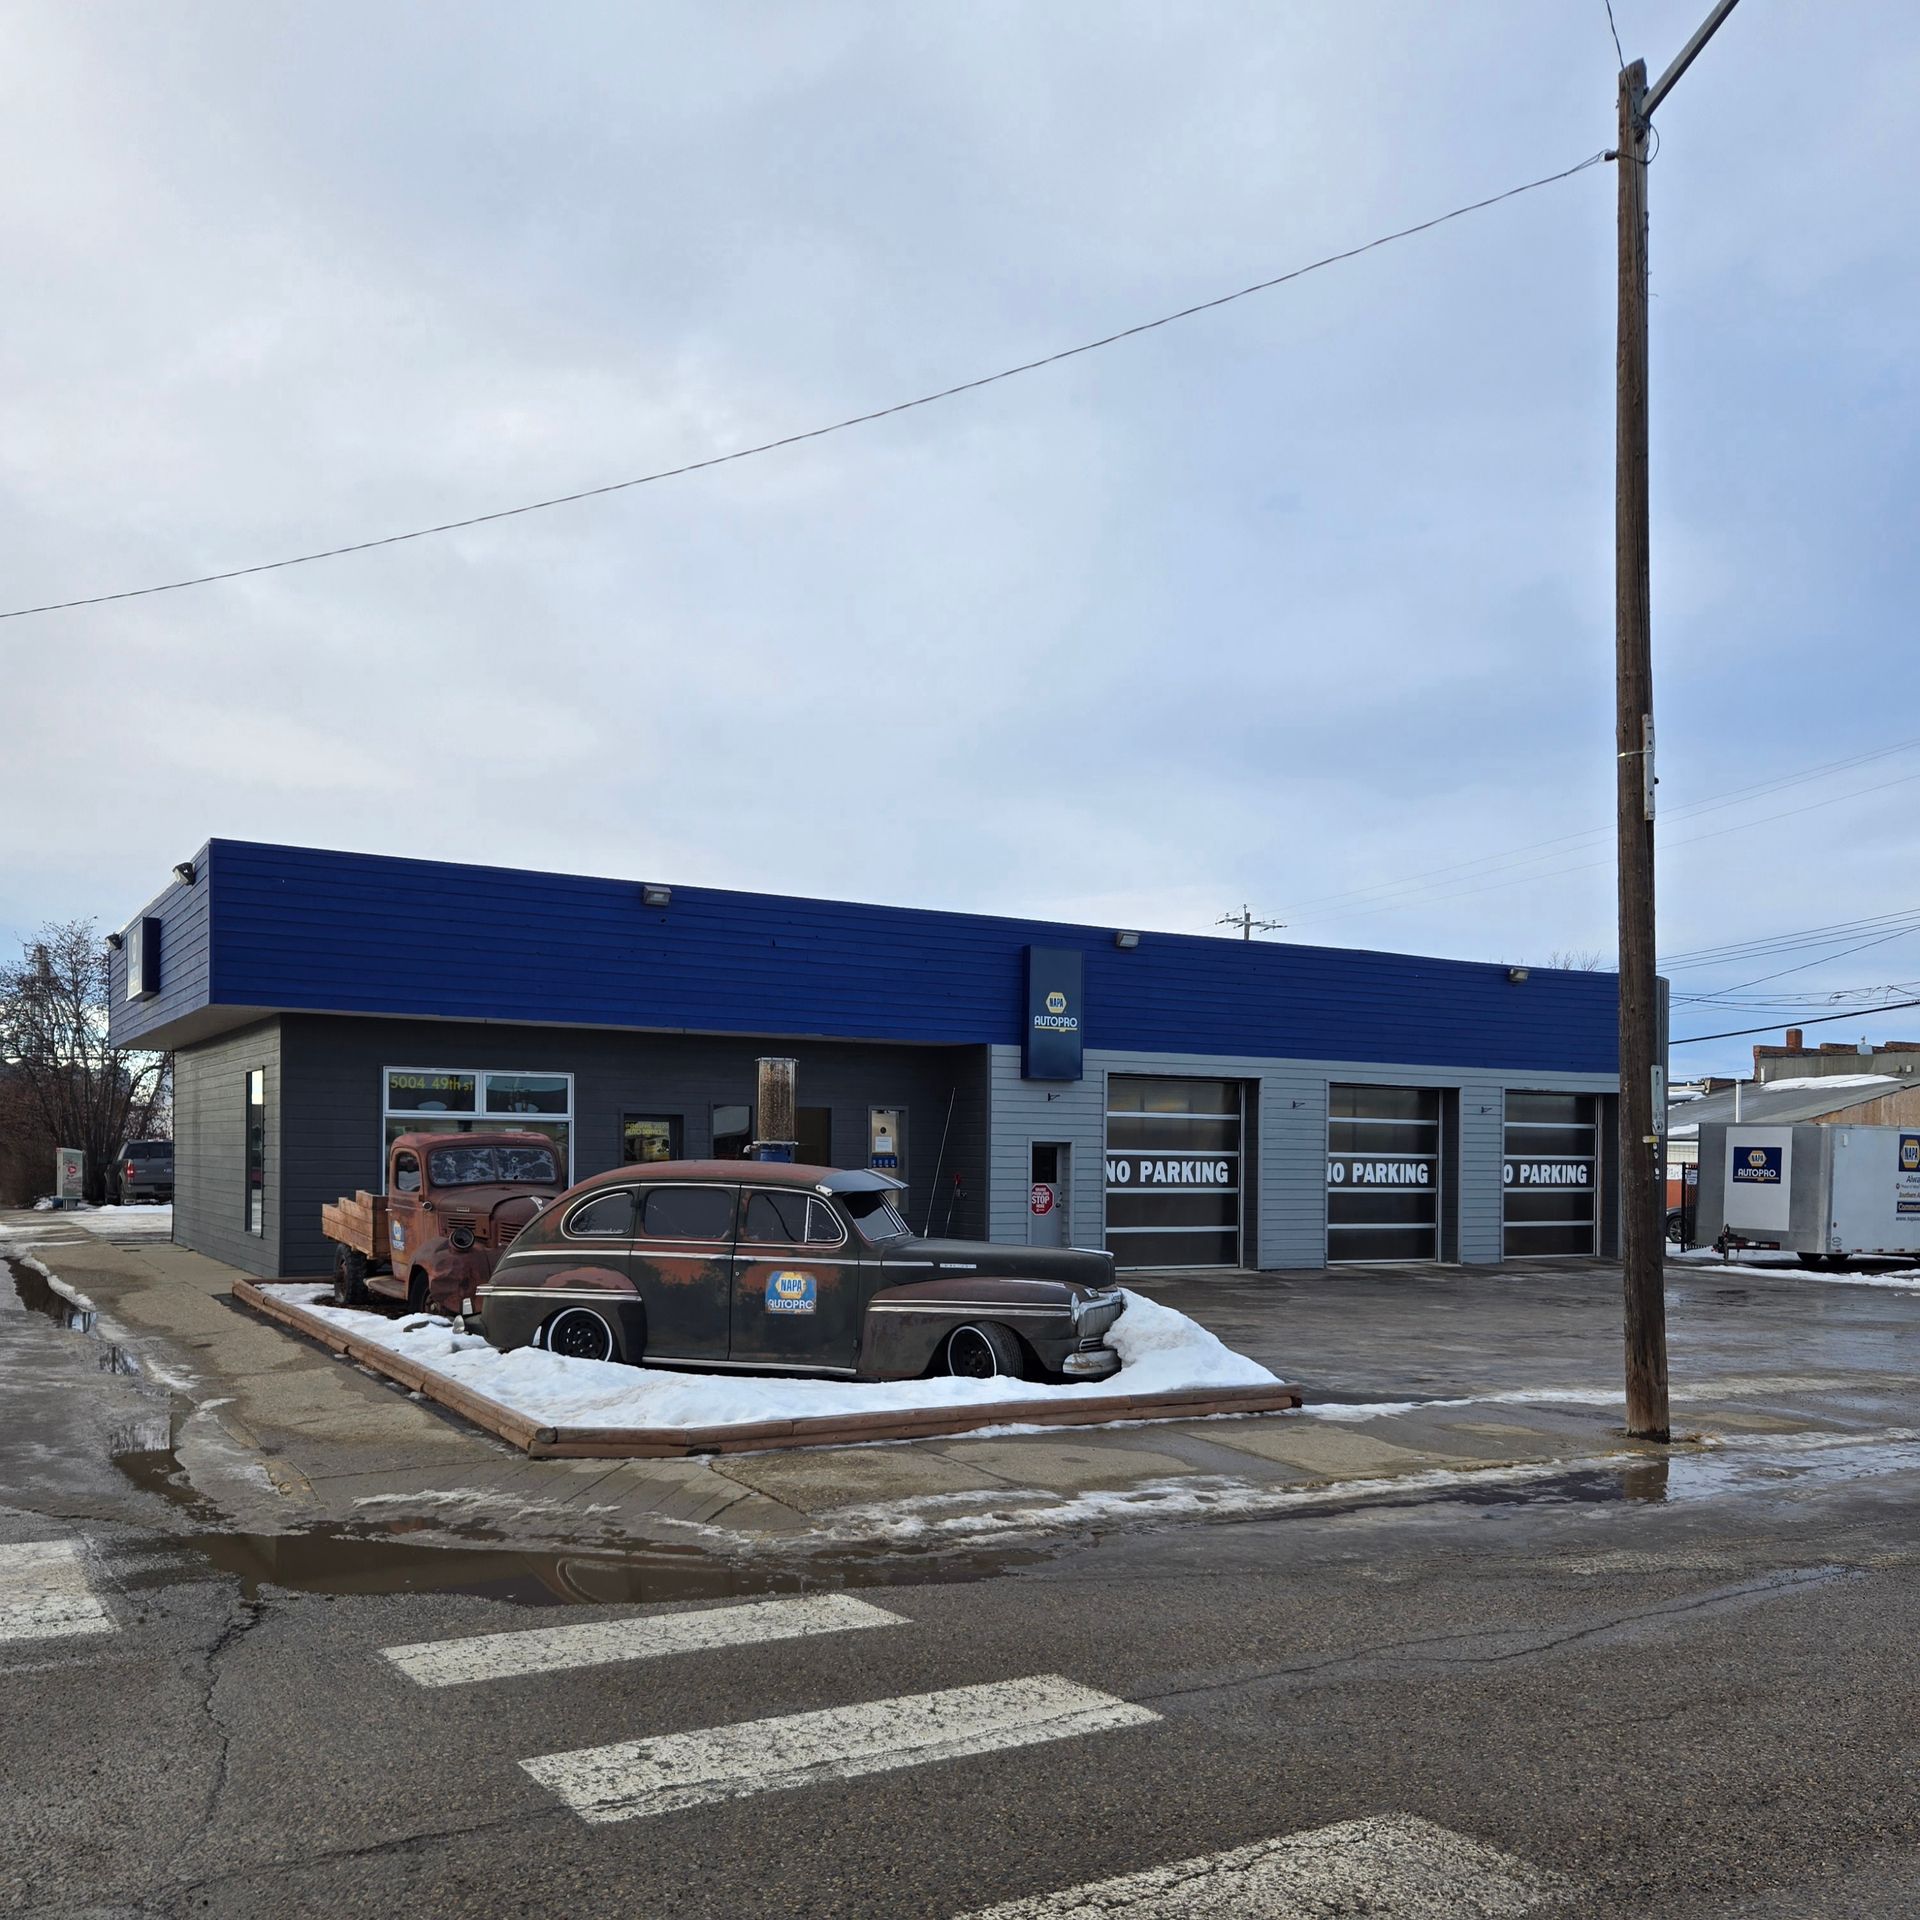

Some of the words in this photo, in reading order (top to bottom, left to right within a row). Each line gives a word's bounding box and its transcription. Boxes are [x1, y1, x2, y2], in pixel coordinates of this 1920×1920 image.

[1049, 997, 1064, 1008] NAPA
[1034, 1015, 1078, 1028] AUTOPRO
[390, 1076, 426, 1089] 5004
[431, 1076, 461, 1091] 49th
[1904, 1147, 1918, 1160] NAPA
[1105, 1160, 1131, 1183] NO
[1139, 1160, 1229, 1183] PARKING
[1352, 1162, 1428, 1184] PARKING
[1503, 1164, 1514, 1184] O
[1519, 1164, 1587, 1184] PARKING
[1738, 1168, 1776, 1177] AUTOPRO
[1032, 1195, 1050, 1204] STOP
[780, 1279, 802, 1292] NAPA
